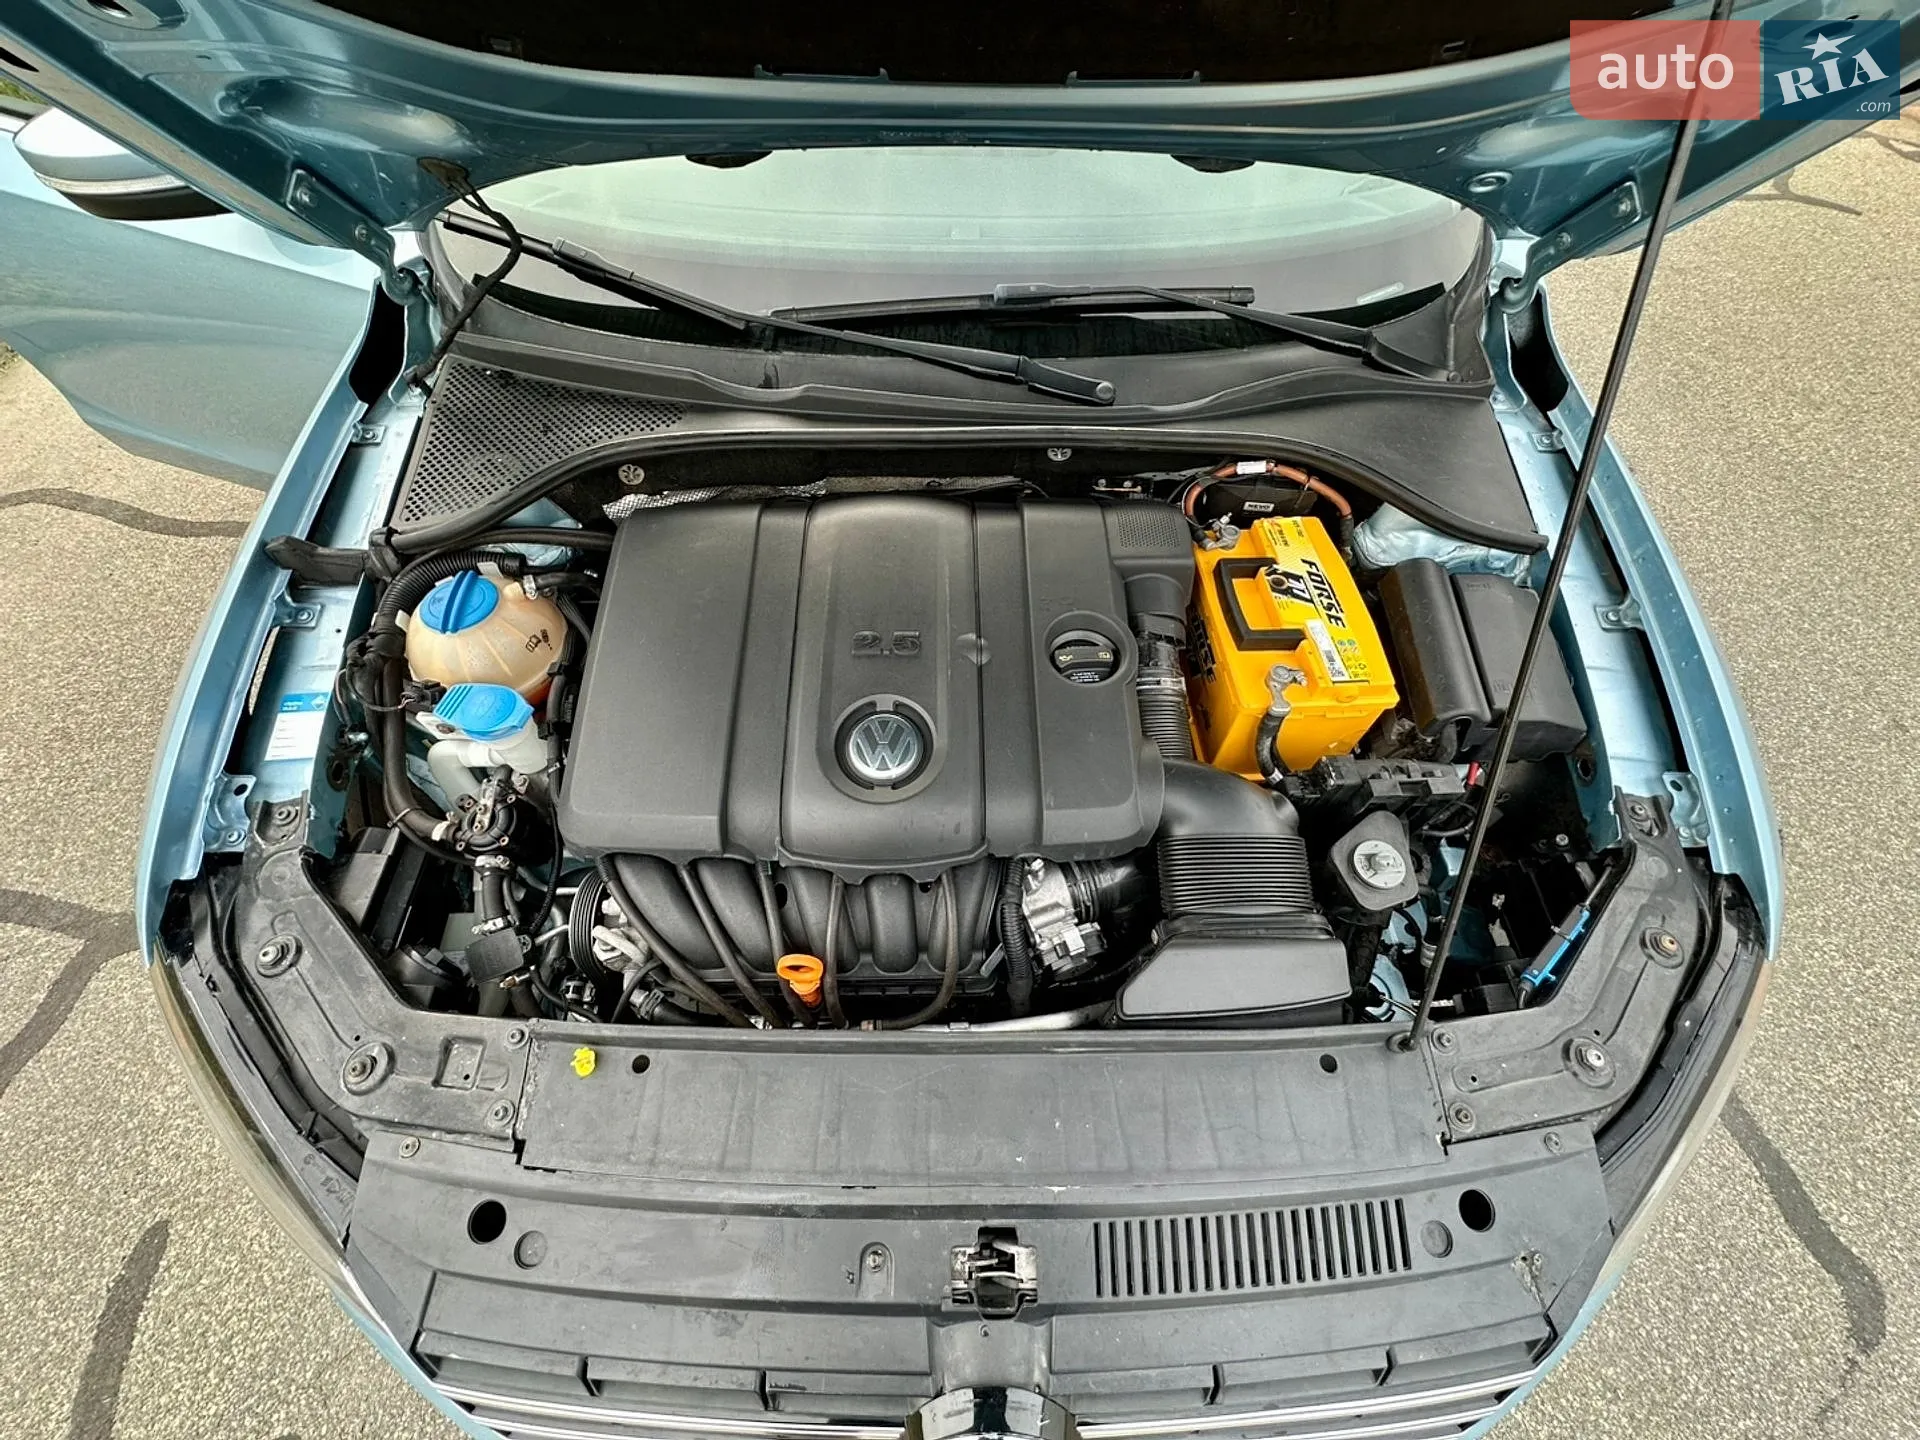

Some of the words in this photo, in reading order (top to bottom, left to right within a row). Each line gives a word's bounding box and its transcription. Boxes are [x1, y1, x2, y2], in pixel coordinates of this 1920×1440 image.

[1300, 558, 1346, 629] FORSE
[850, 630, 921, 657] 2.5
[852, 716, 920, 774] VW
